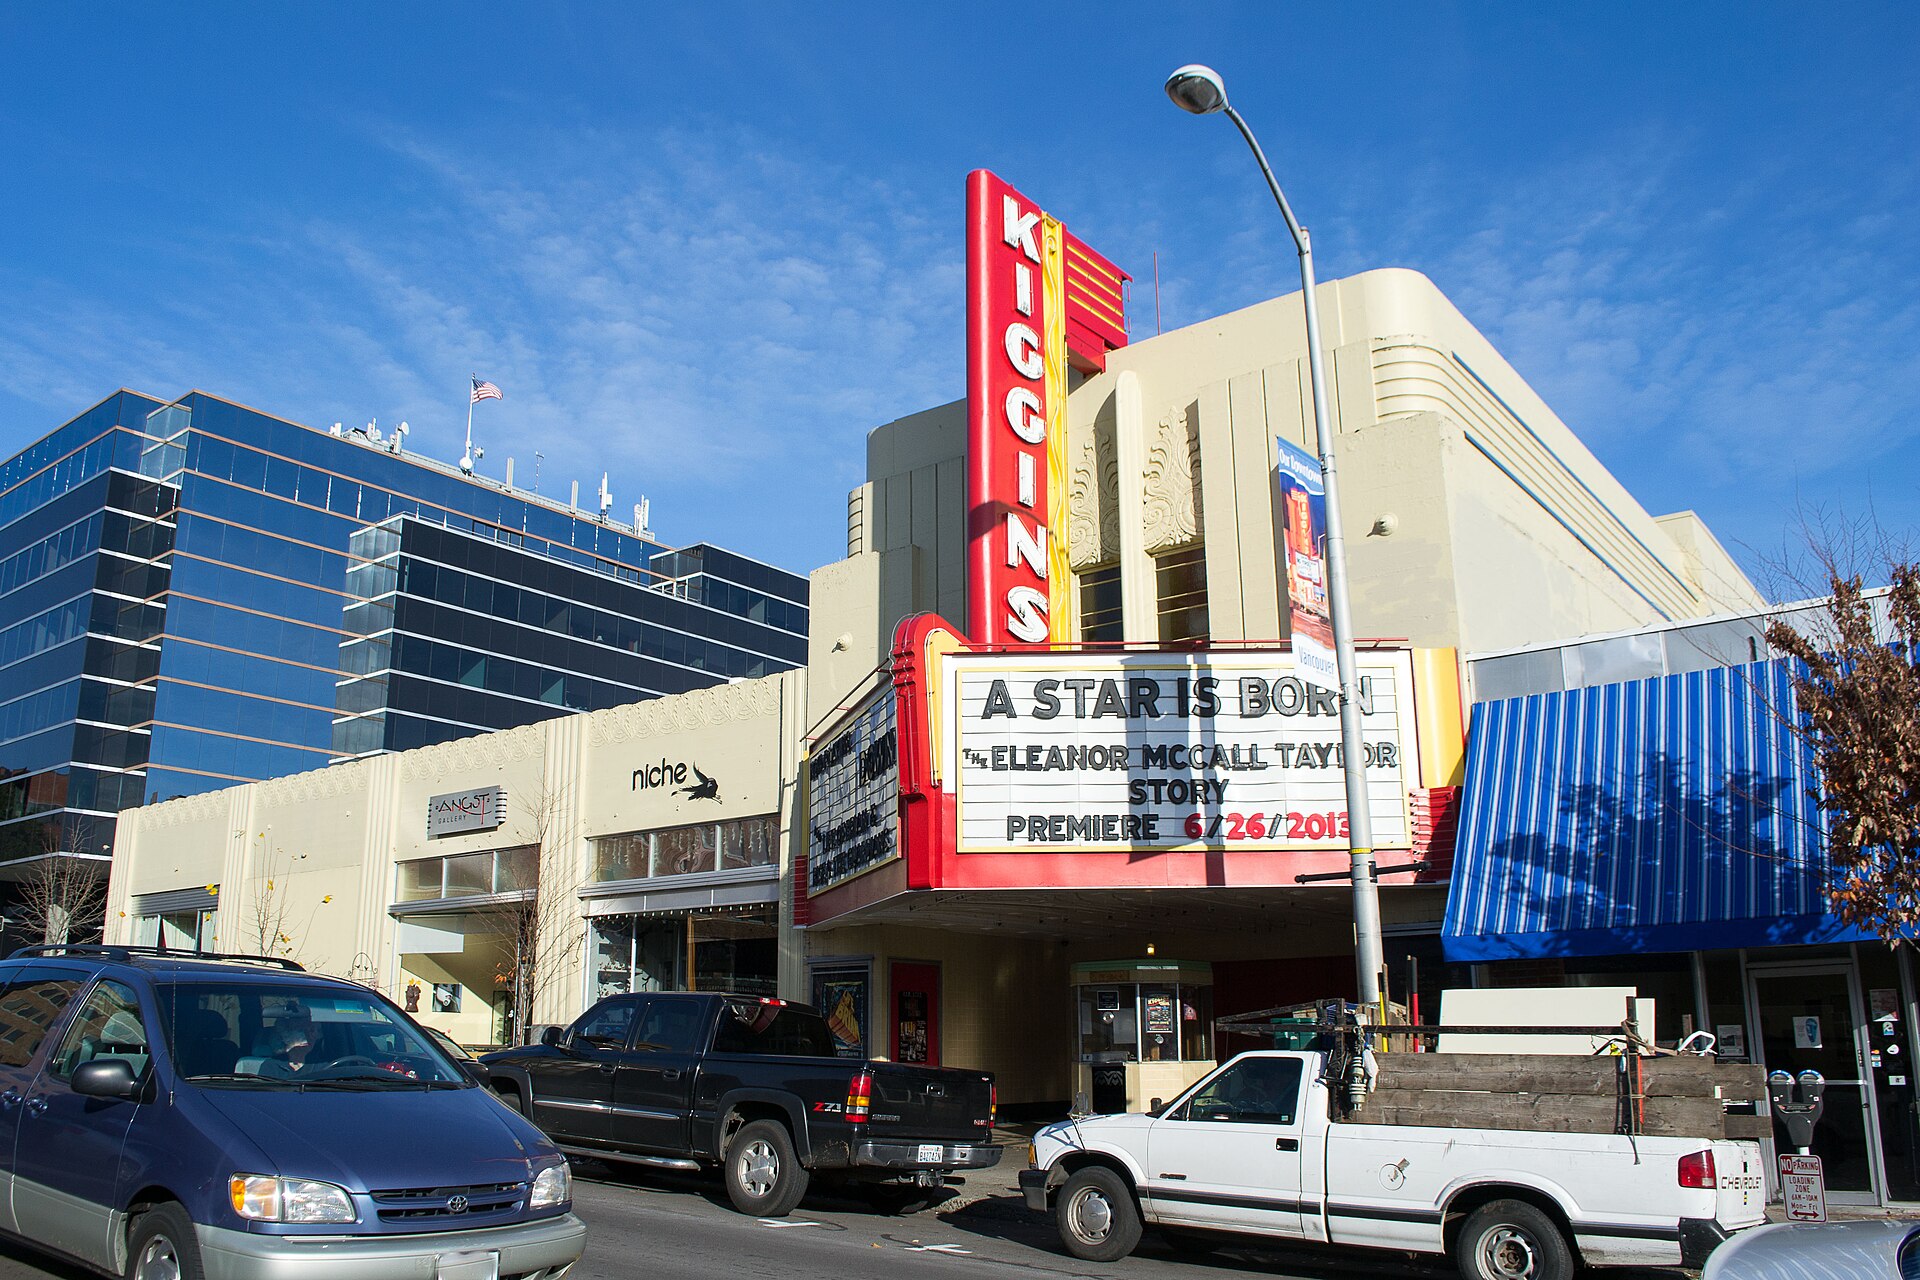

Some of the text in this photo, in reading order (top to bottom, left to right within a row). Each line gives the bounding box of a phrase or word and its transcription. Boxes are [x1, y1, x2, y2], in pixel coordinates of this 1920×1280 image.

[1002, 192, 1050, 643] KIGGINS
[1279, 448, 1291, 467] Our
[1298, 645, 1334, 674] Vancouver
[981, 678, 1017, 720] A
[1031, 677, 1161, 720] STAR
[1177, 676, 1221, 719] IS
[963, 748, 988, 769] THE
[991, 744, 1129, 771] ELEANOR
[1142, 743, 1268, 771] MCCALL
[632, 757, 688, 791] niche
[1128, 778, 1230, 805] STORY
[438, 793, 491, 824] ANGST
[438, 815, 467, 825] GALLERY
[1006, 811, 1349, 841] PREMIERE 6/26/2013
[813, 1102, 842, 1112] Z71
[1781, 1158, 1818, 1171] NO PARKING
[1721, 1176, 1761, 1190] CHEVROLET
[1789, 1176, 1815, 1185] LOADING
[1795, 1185, 1810, 1193] ZONE
